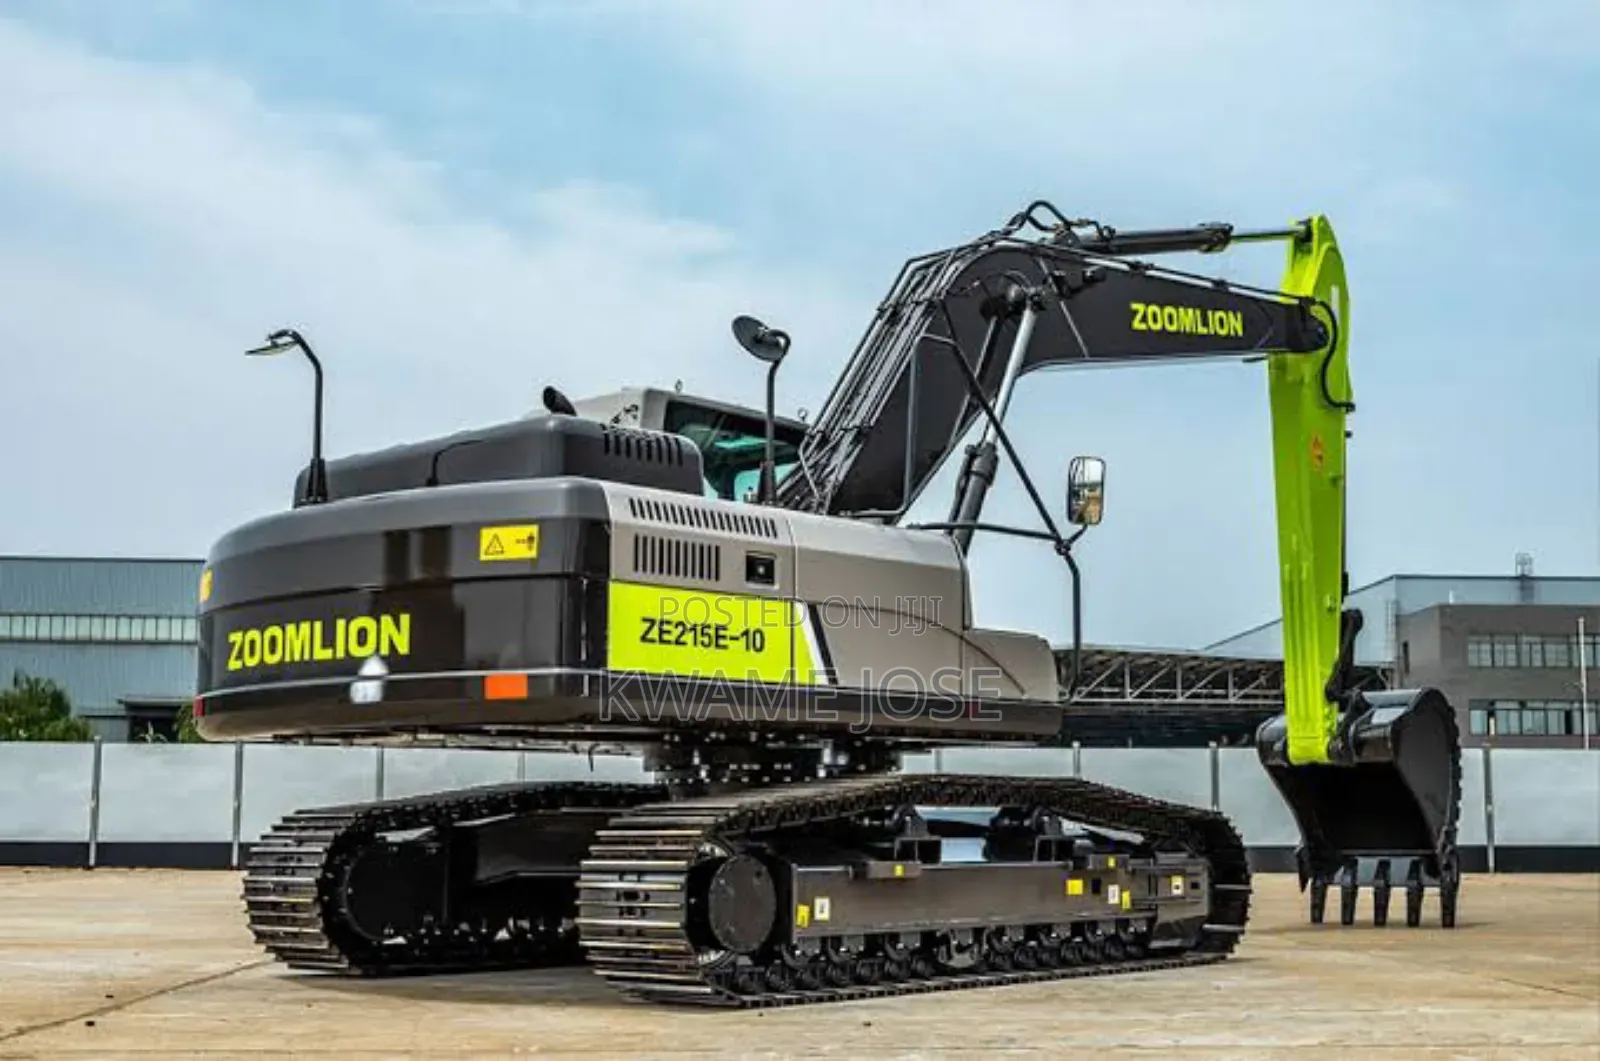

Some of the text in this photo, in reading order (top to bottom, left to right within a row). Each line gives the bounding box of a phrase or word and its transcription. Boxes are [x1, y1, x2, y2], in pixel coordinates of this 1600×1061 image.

[1130, 302, 1244, 337] ZOOMLION
[227, 613, 411, 671] ZOOMLION
[639, 617, 765, 653] ZE215E-10
